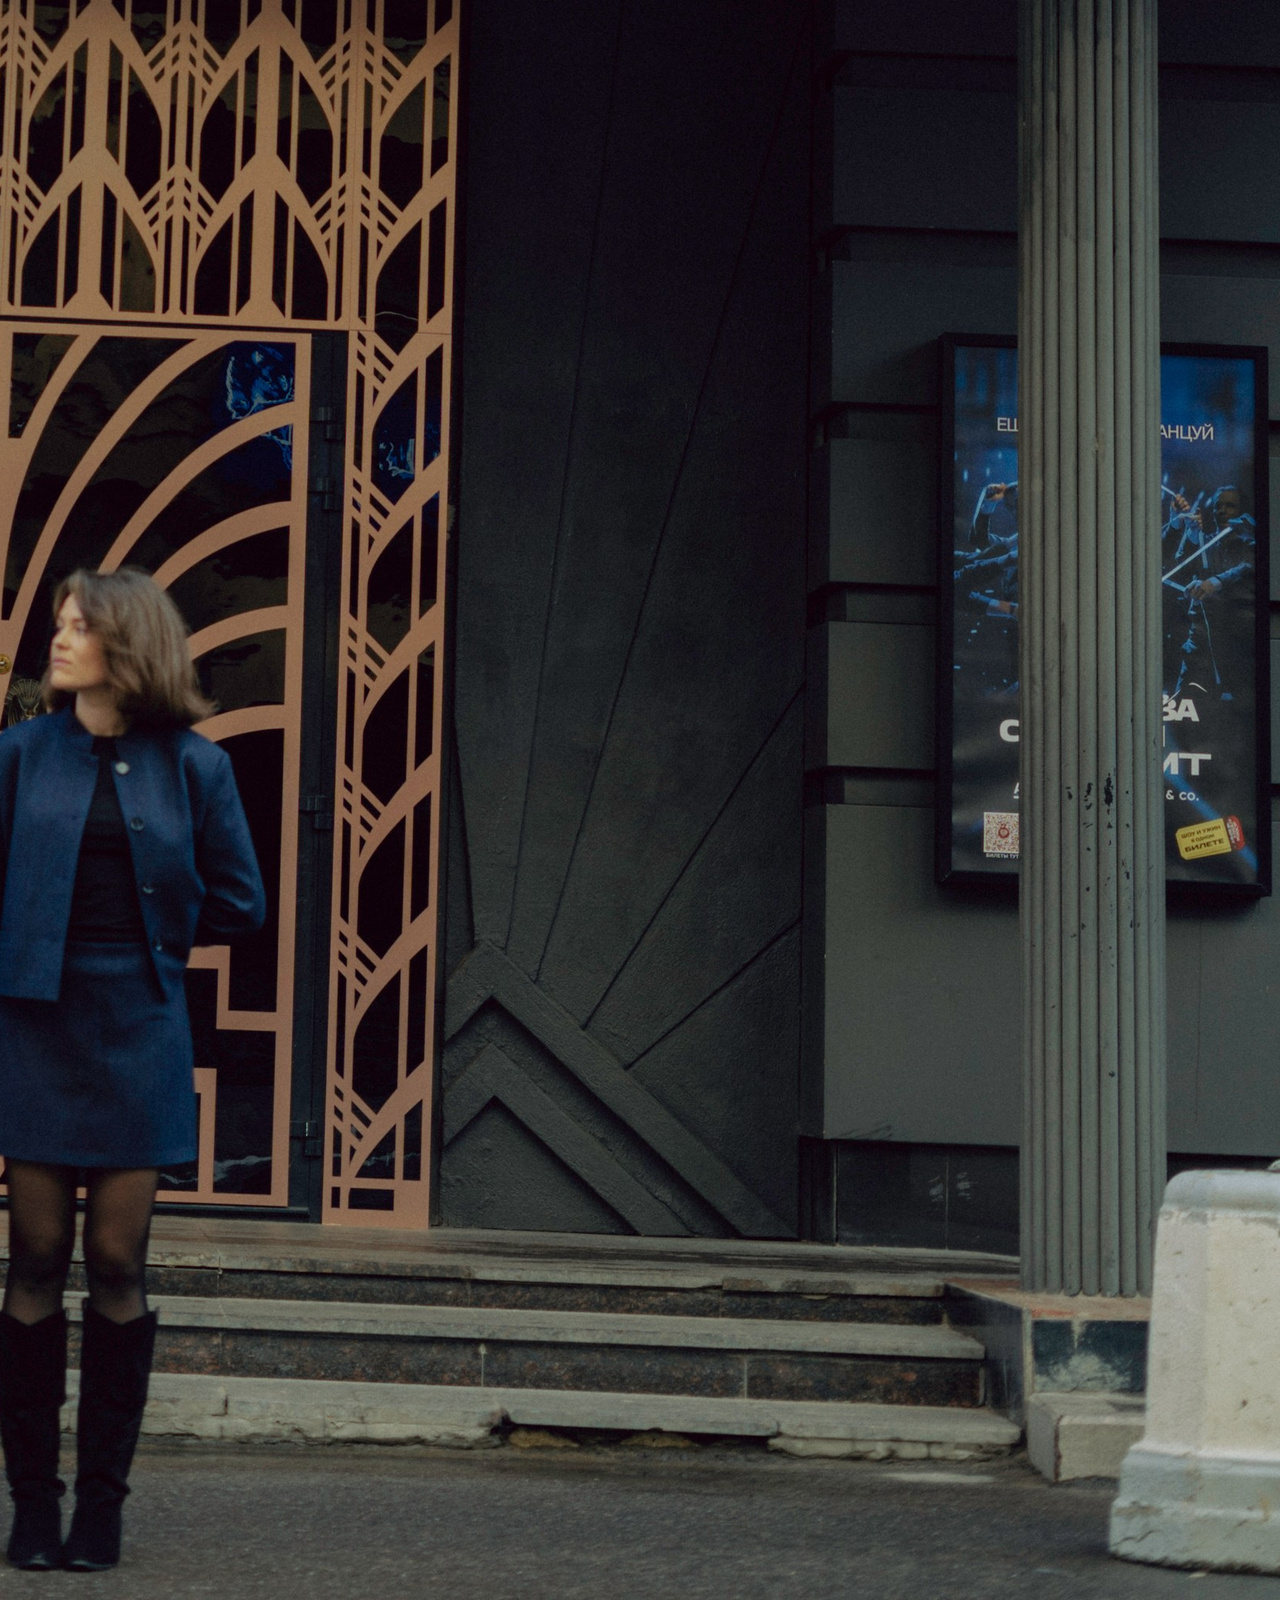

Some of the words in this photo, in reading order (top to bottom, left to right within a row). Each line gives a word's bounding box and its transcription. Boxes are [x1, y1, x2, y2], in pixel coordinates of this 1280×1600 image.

[1160, 423, 1214, 442] АНЦУЙ
[1166, 789, 1174, 800] &
[1185, 838, 1224, 852] БИЛЕТЕ
